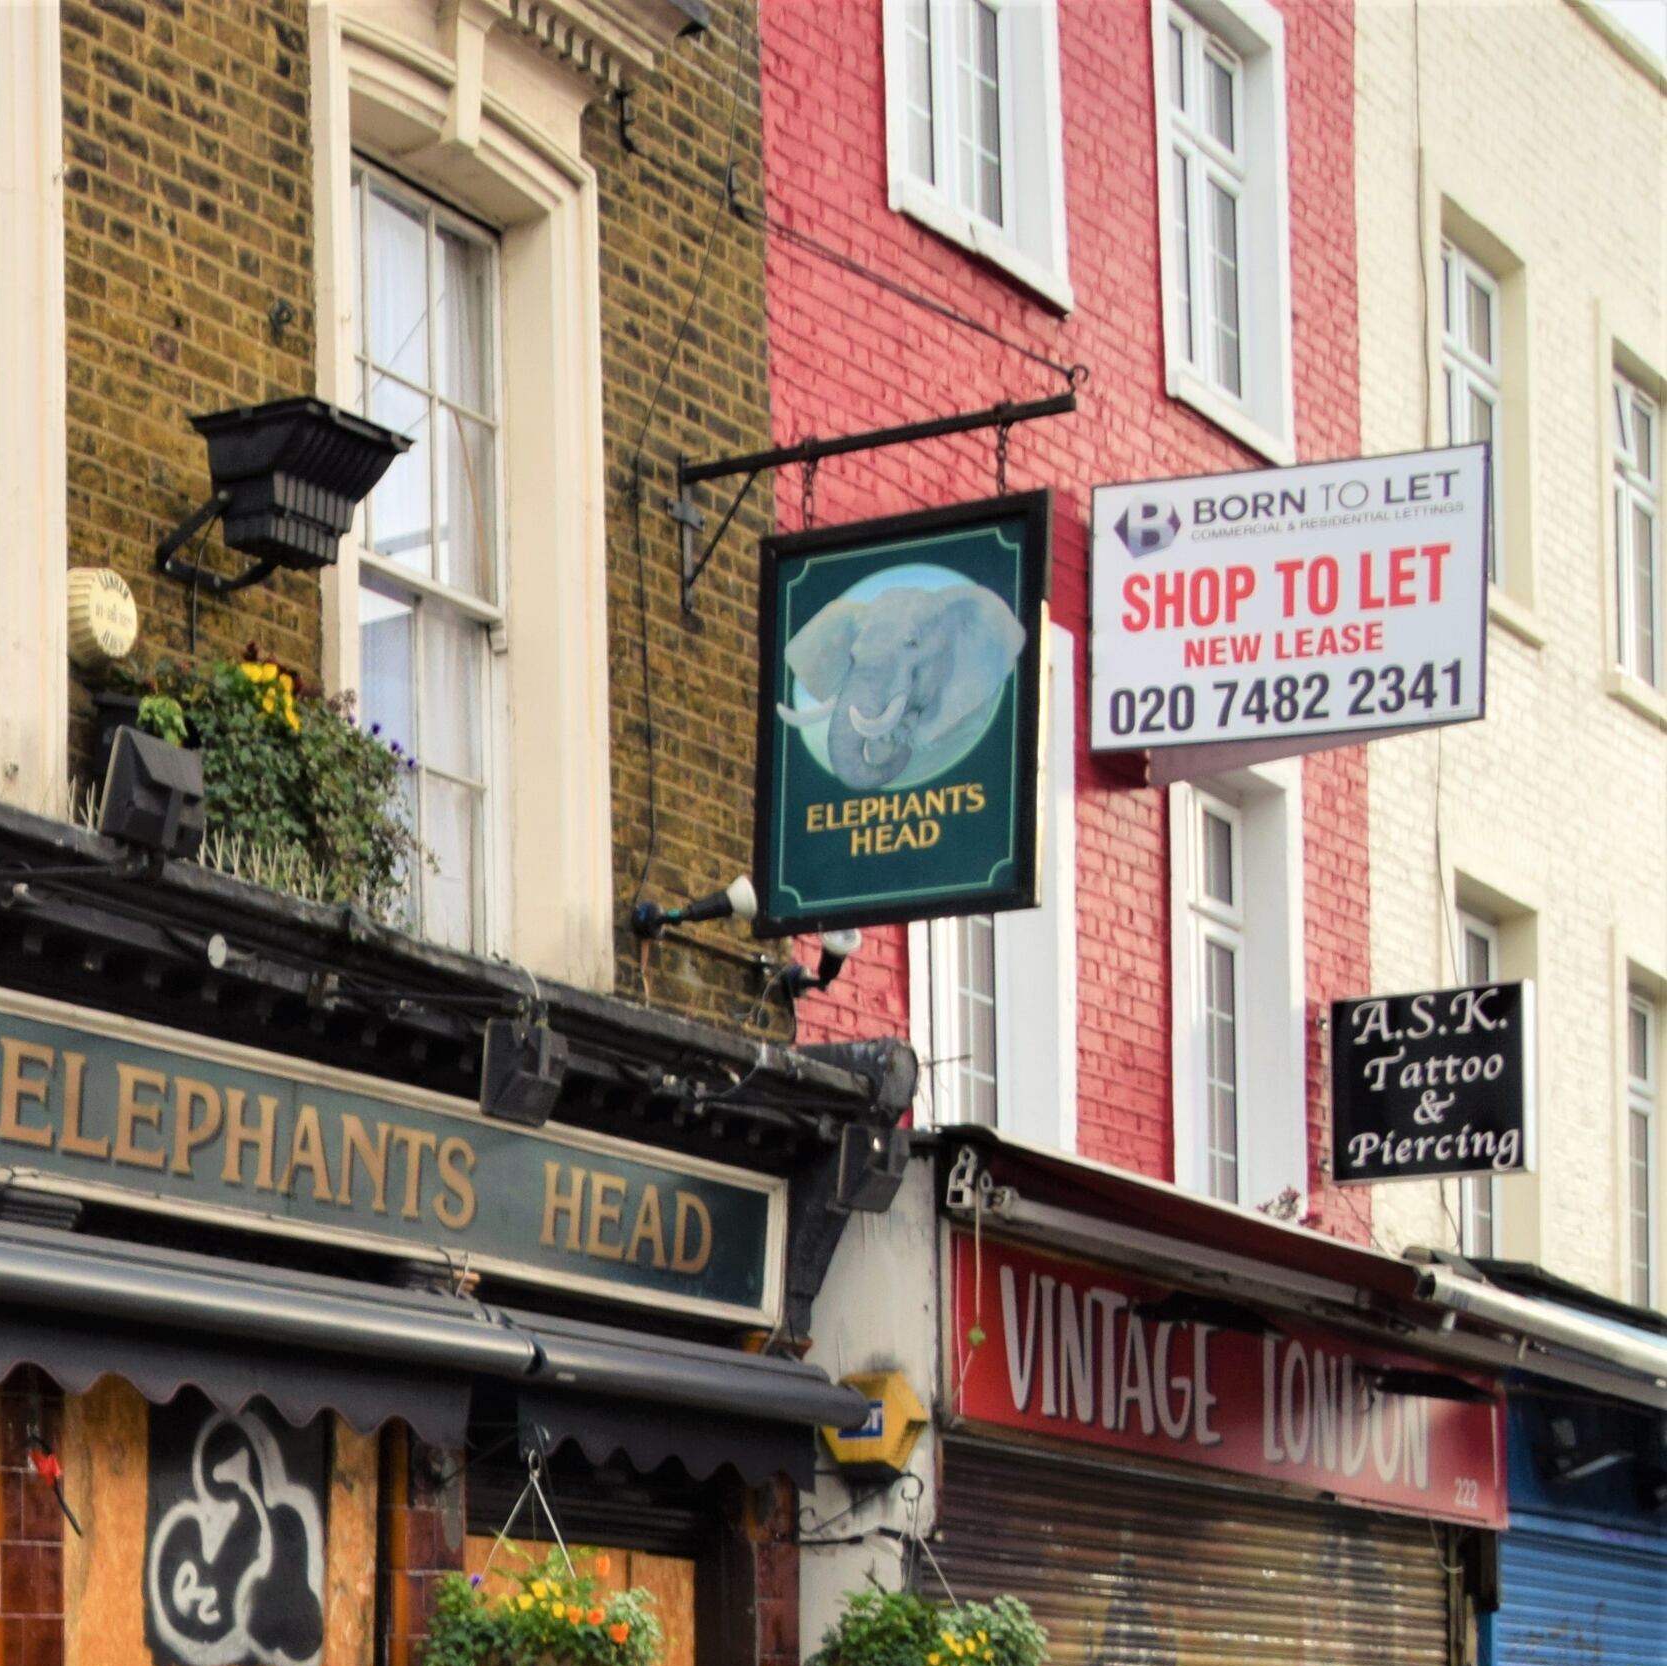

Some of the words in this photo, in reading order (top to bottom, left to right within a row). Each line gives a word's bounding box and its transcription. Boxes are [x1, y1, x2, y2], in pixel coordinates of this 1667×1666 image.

[1192, 487, 1306, 525] BORN
[1320, 480, 1369, 511] TO
[1383, 469, 1461, 506] LET
[1190, 522, 1282, 542] COMMERCIAL
[1286, 519, 1296, 532] &
[1299, 509, 1391, 531] RESIDENTIAL
[1394, 501, 1465, 521] LETTINGS
[1121, 564, 1256, 632] SHOP
[1274, 555, 1340, 618] TO
[1359, 543, 1452, 610] LET
[1183, 633, 1262, 668] NEW
[1274, 621, 1384, 661] LEASE
[1109, 683, 1195, 735] 020
[1212, 672, 1330, 728] 7482
[1348, 658, 1462, 717] 2341
[850, 818, 941, 858] HEAD
[1351, 988, 1509, 1045] A.S.K.
[1363, 1045, 1505, 1091] Tattoo
[1413, 1089, 1456, 1126] &
[1347, 1123, 1520, 1171] Piercing
[538, 1161, 714, 1276] HEAD
[999, 1264, 1222, 1446] VINTAGE
[1263, 1336, 1431, 1490] LONDON
[1453, 1477, 1479, 1509] 222
